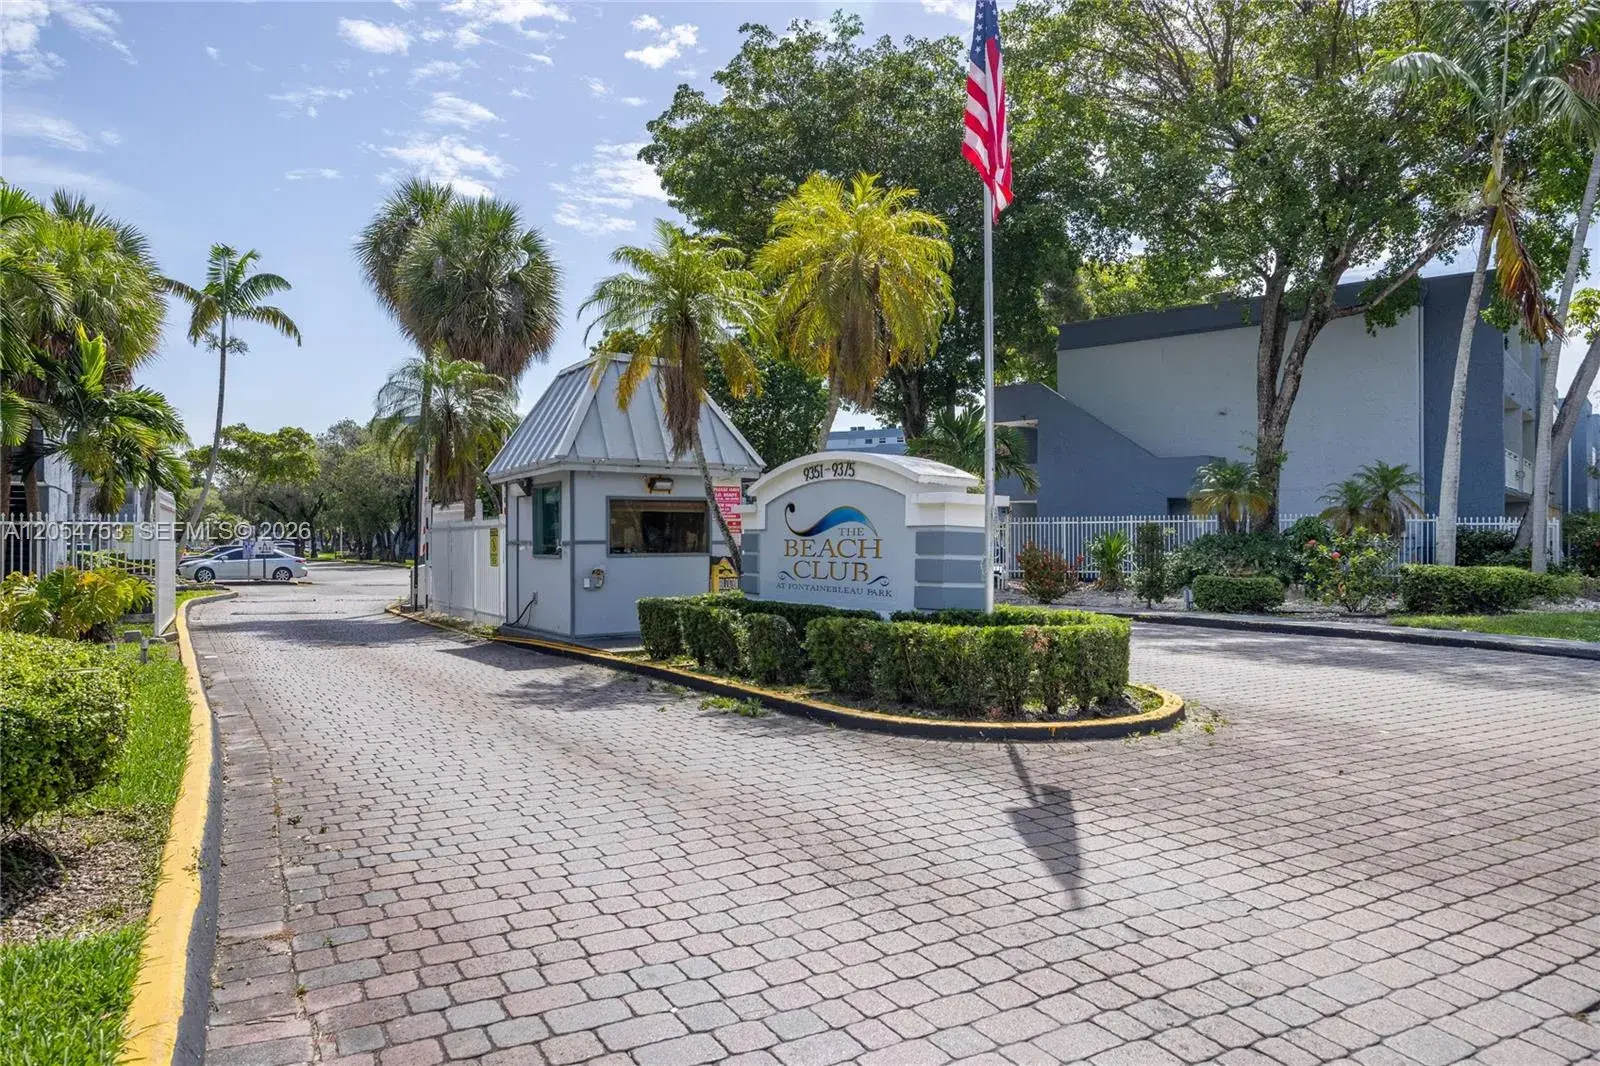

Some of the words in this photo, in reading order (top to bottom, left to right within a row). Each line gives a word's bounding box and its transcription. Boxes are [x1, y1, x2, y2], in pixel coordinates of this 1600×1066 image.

[803, 463, 855, 480] 9351-9375
[838, 527, 865, 537] THE
[784, 538, 883, 559] BEACH
[793, 560, 869, 581] CLUB
[788, 582, 864, 596] FONTAINEBLEAU
[866, 588, 892, 597] PARK
